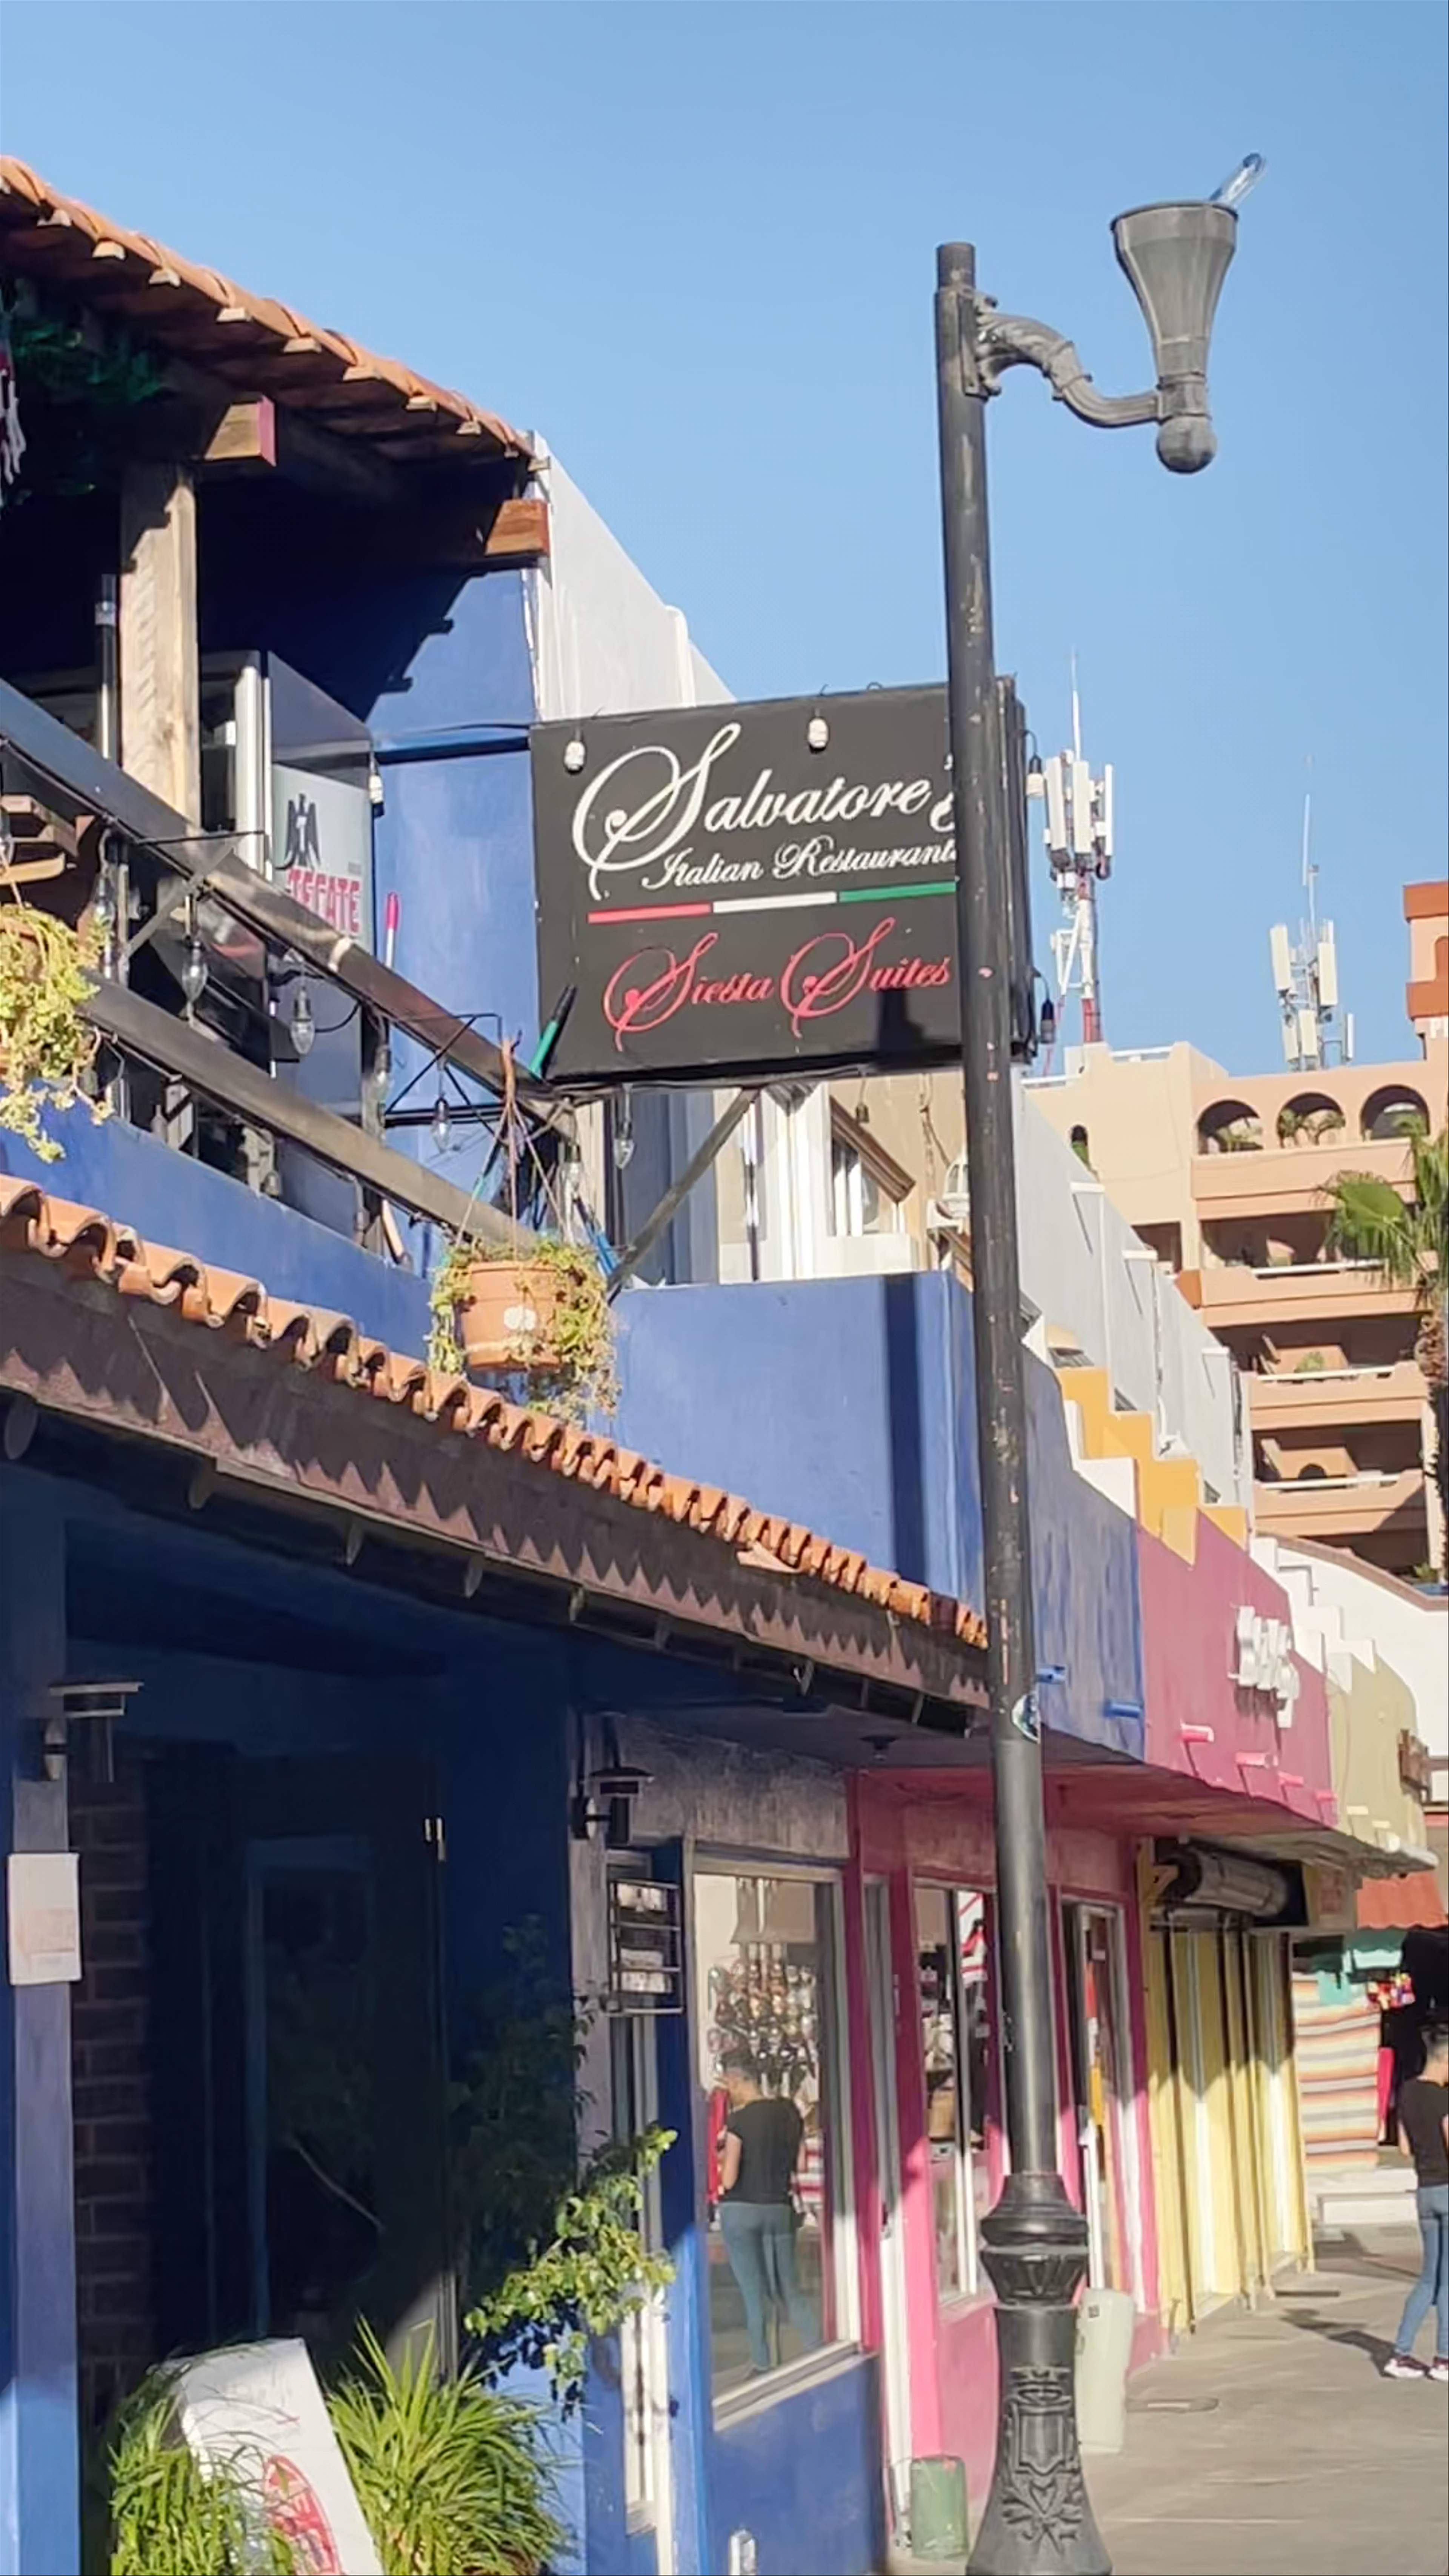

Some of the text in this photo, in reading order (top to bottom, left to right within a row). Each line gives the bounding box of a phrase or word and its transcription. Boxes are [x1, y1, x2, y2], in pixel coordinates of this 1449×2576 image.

[572, 723, 932, 900] Salvatore
[641, 835, 956, 890] Italian Restaurant
[604, 917, 951, 1052] Siesta Suites
